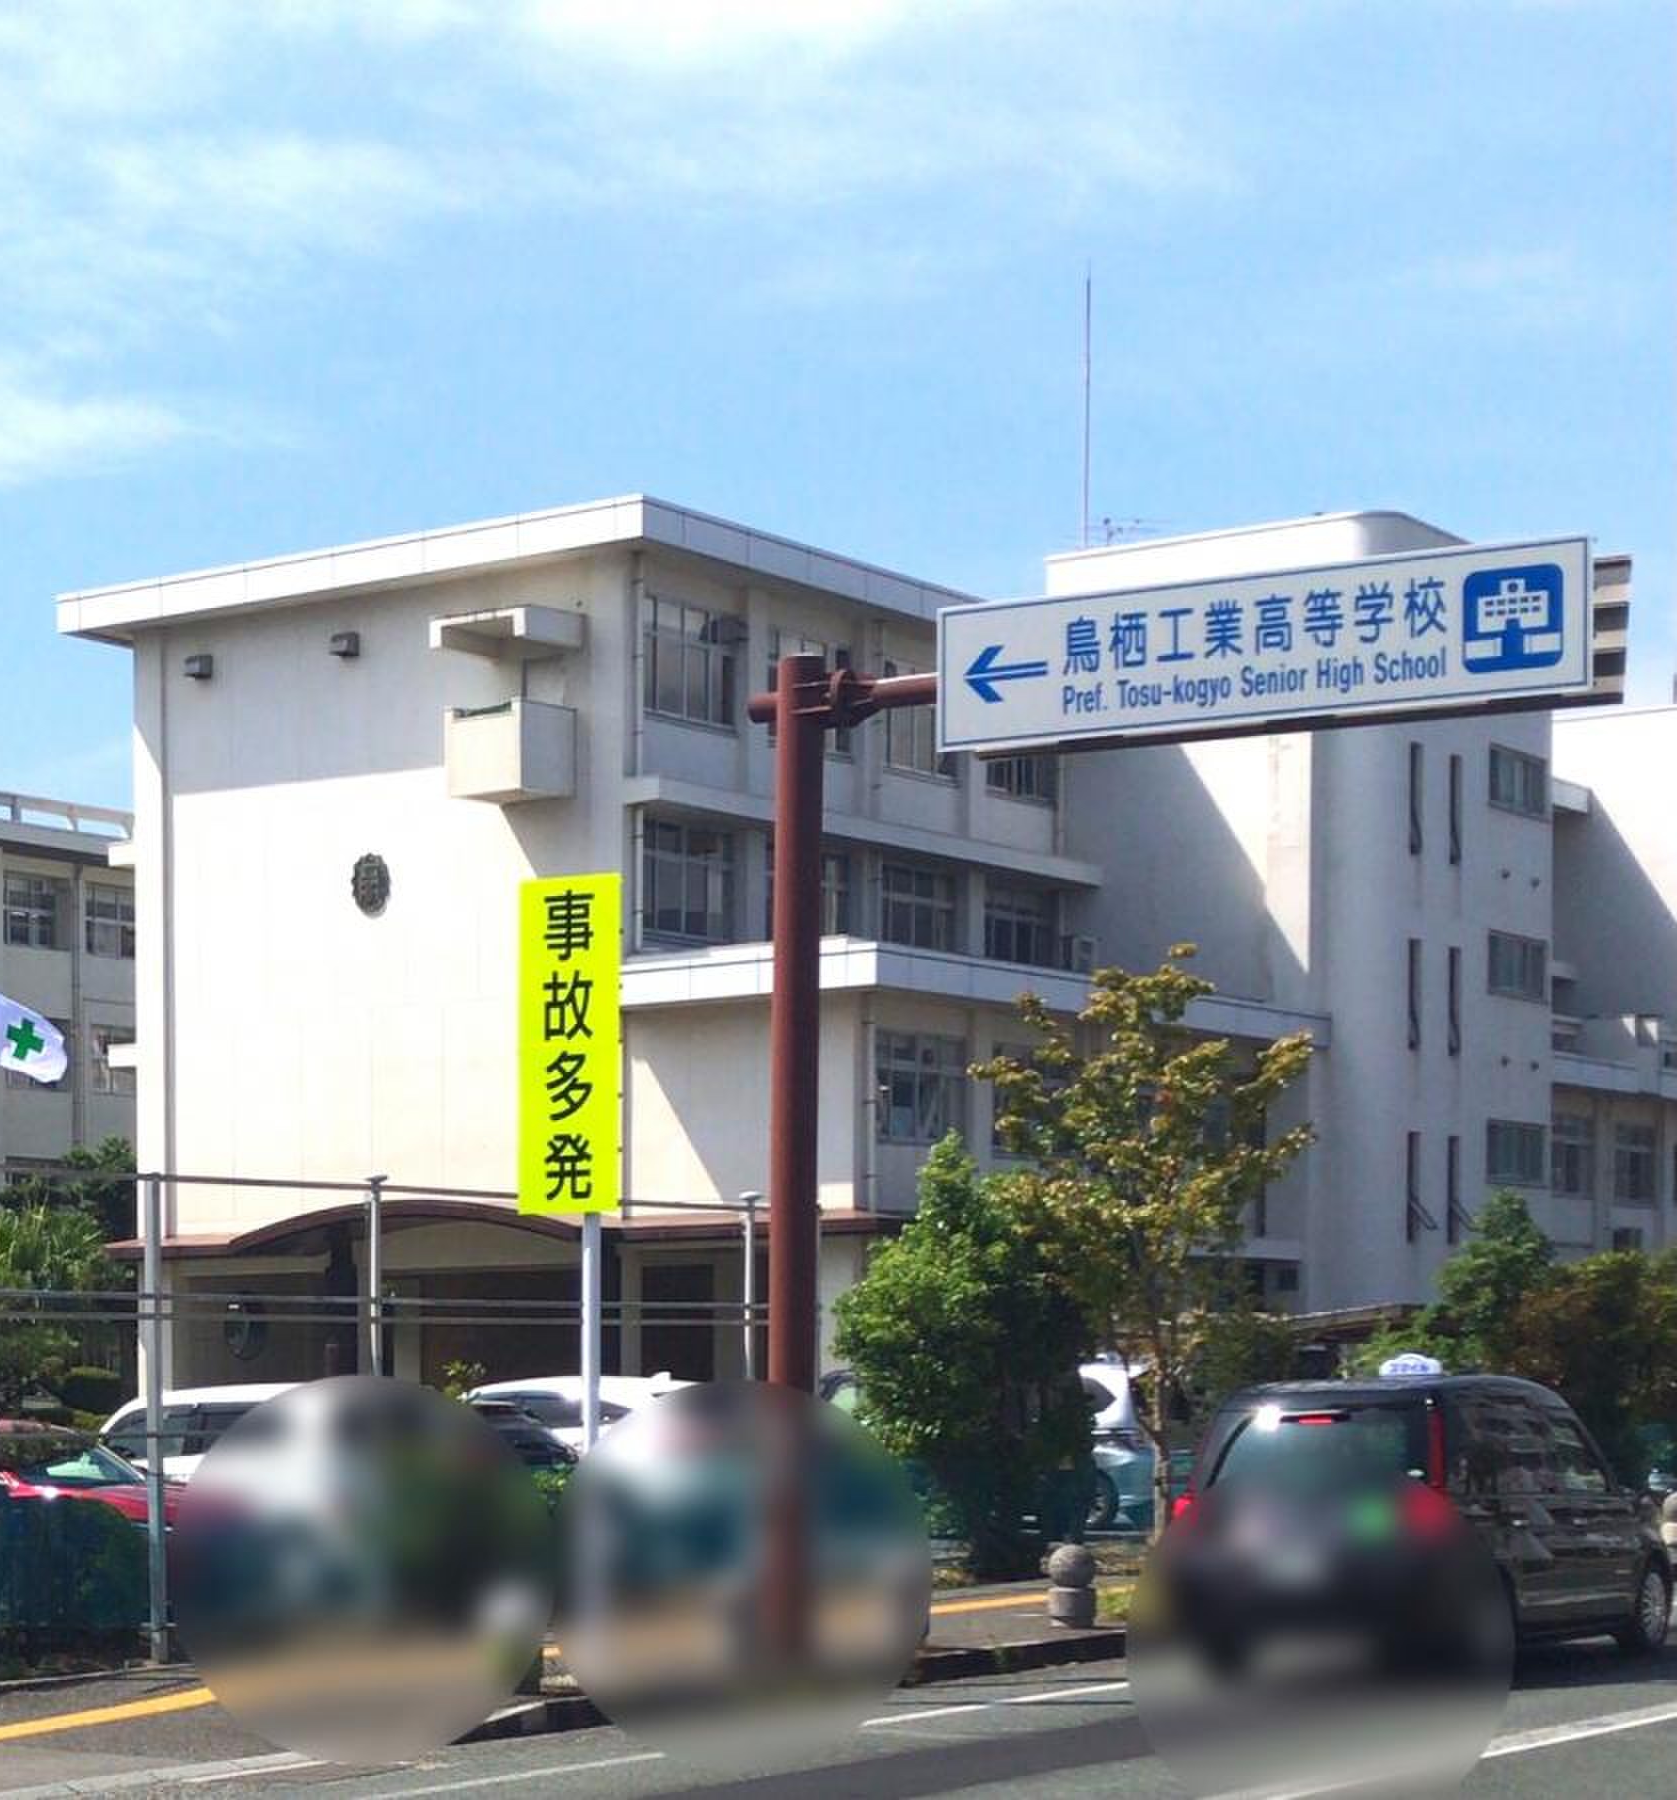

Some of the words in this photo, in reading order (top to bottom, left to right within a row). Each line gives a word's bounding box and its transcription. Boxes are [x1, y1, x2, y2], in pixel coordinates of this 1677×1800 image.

[1062, 575, 1447, 676] 鳥栖工業高等学校
[1062, 685, 1108, 715] Pref.
[1117, 674, 1232, 709] Tosu-kogyo
[1240, 664, 1308, 698] Senior
[1316, 653, 1364, 694] High
[1373, 646, 1447, 684] School
[542, 889, 595, 1201] 事故多発
